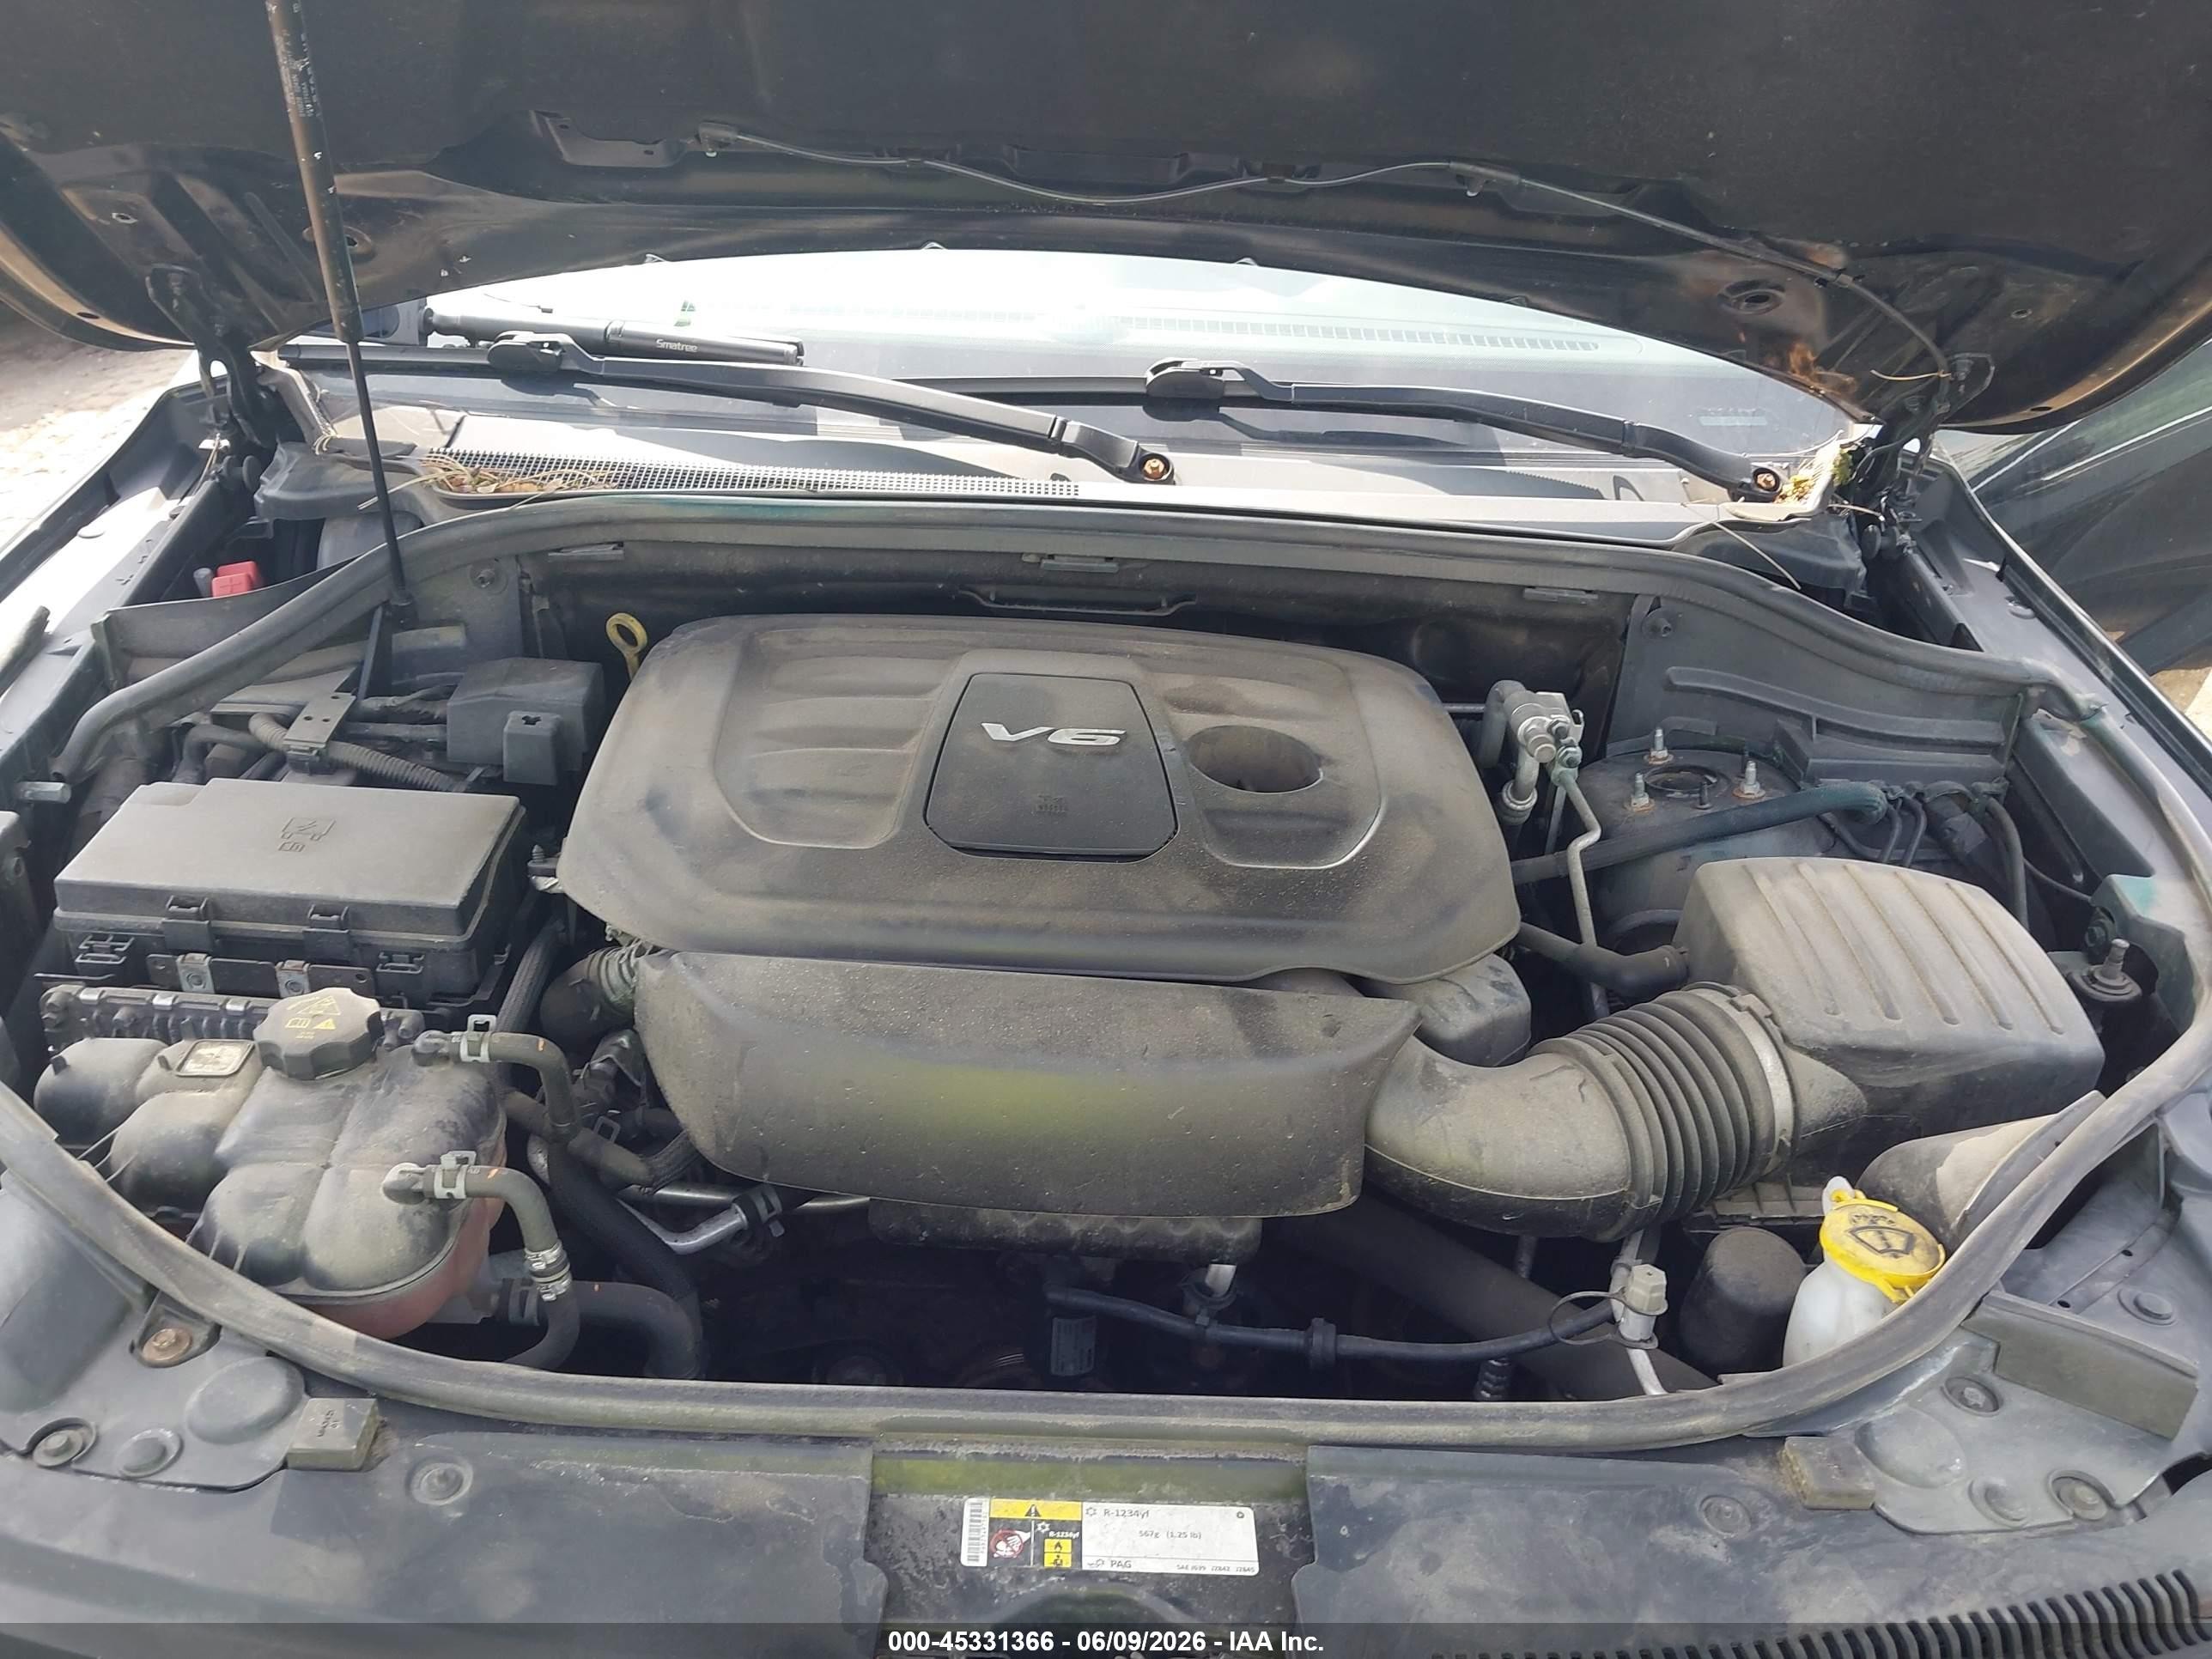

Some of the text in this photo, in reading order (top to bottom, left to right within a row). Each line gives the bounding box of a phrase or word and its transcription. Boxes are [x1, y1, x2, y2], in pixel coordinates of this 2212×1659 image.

[655, 338, 699, 353] Smatree
[981, 722, 1127, 746] V6
[1103, 1509, 1150, 1519] R-1234yf
[1110, 1559, 1132, 1568] PAG
